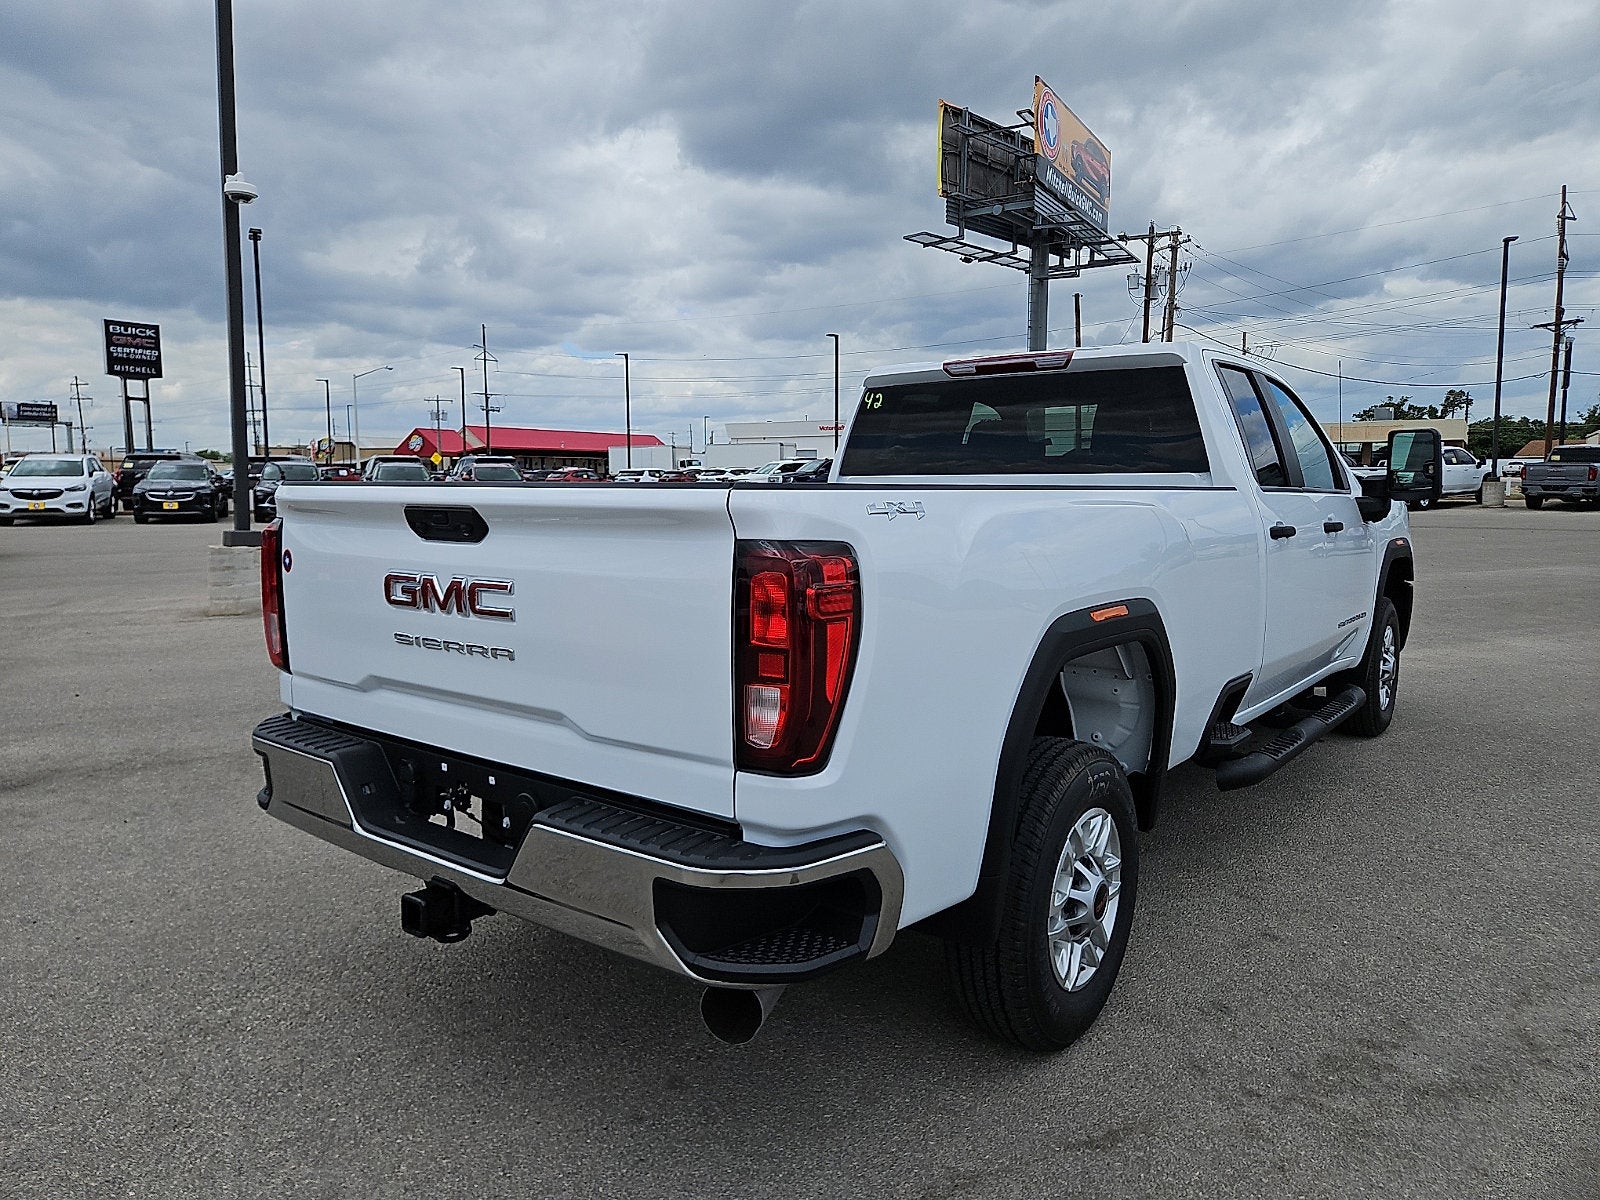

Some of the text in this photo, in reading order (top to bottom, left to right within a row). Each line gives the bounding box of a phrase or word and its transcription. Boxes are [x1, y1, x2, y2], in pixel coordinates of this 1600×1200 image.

[109, 325, 156, 337] BUICK
[112, 336, 155, 347] GMC
[110, 346, 159, 356] CERTIFIED
[114, 364, 156, 374] MITCHELL
[865, 391, 882, 409] 42
[383, 571, 515, 622] GMC
[394, 631, 515, 661] SIERRA
